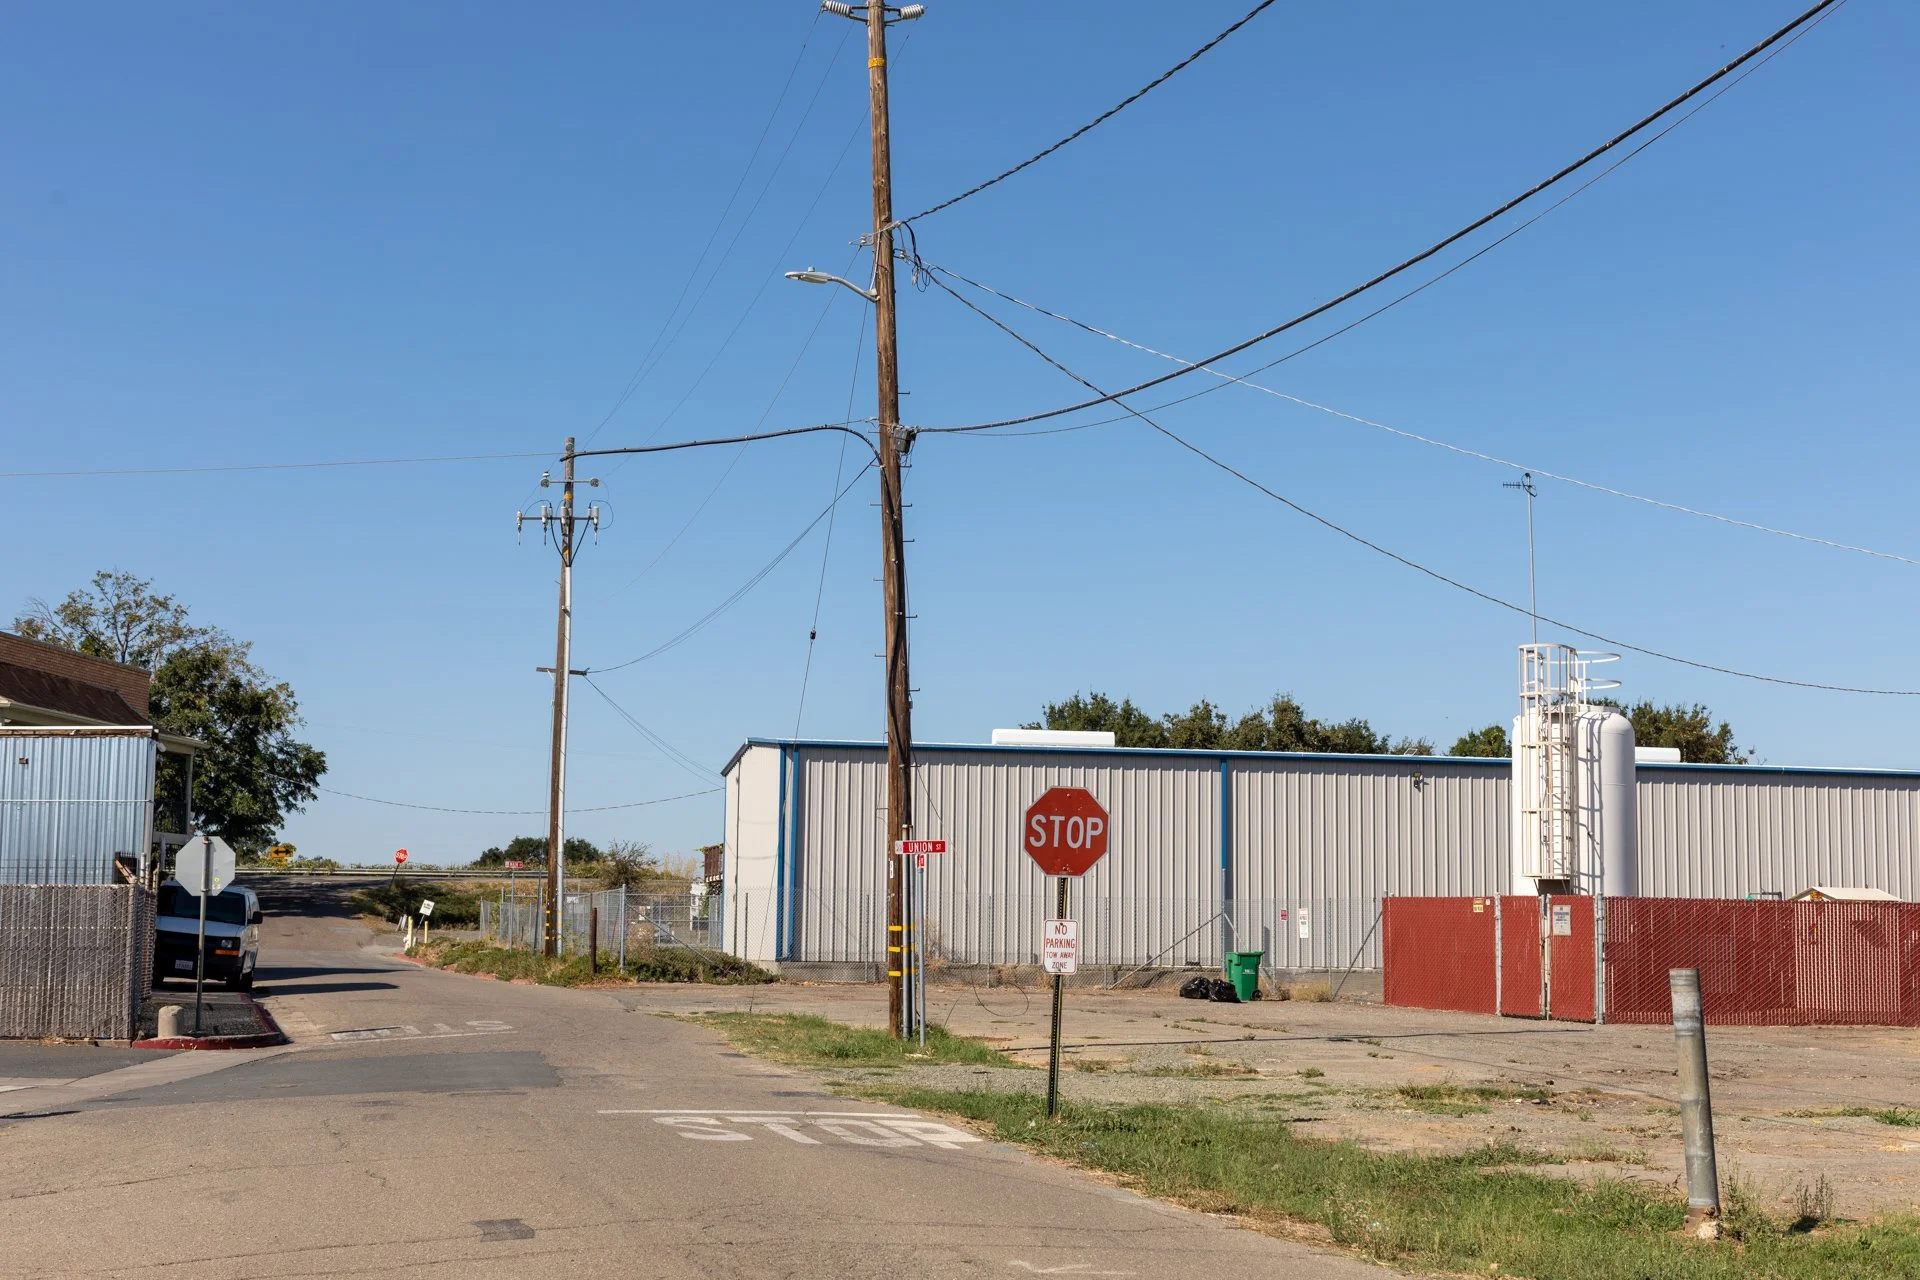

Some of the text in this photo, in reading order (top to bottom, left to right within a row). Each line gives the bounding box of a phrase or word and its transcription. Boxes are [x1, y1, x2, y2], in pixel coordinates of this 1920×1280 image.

[1030, 814, 1103, 848] STOP
[908, 842, 933, 852] UNION
[935, 843, 942, 851] ST
[1054, 924, 1068, 935] NO
[1045, 938, 1076, 949] PARKING
[1046, 951, 1074, 959] TOW AWAY
[1051, 961, 1068, 969] ZONE
[653, 1115, 984, 1150] STOP
